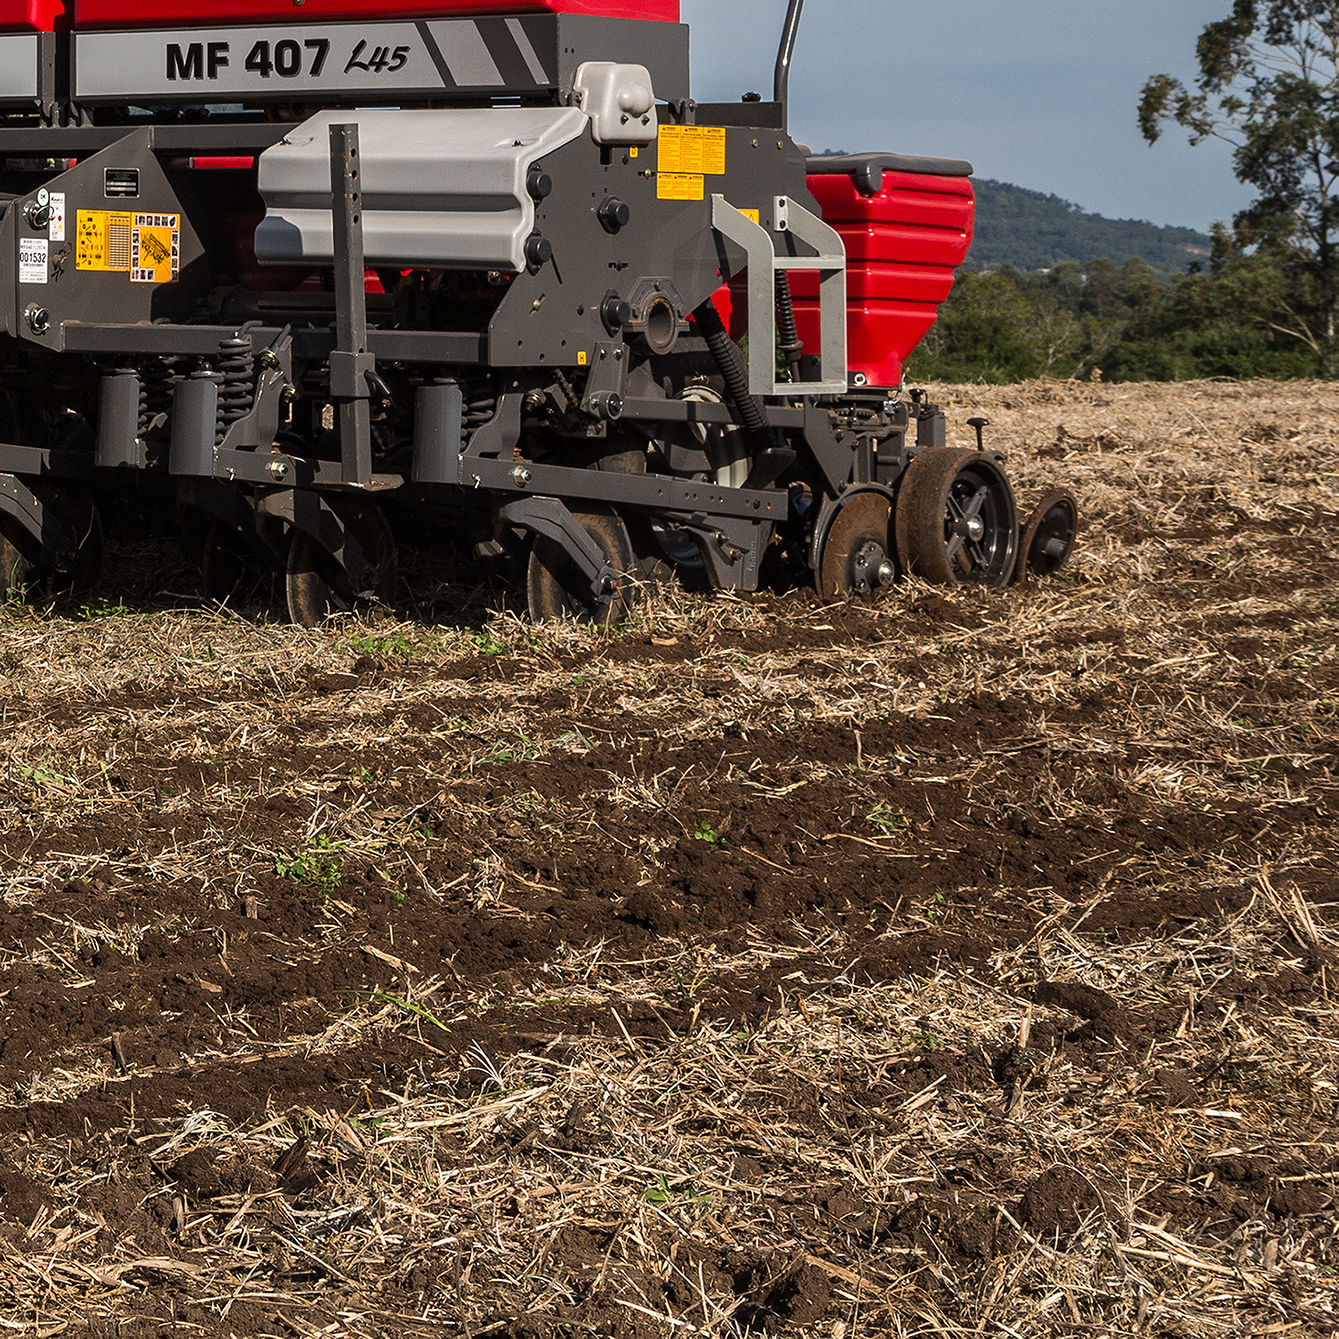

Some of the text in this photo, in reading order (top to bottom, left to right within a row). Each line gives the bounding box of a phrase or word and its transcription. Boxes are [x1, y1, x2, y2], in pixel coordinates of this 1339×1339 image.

[165, 37, 412, 81] MF 407 L45
[19, 252, 46, 263] 001532
